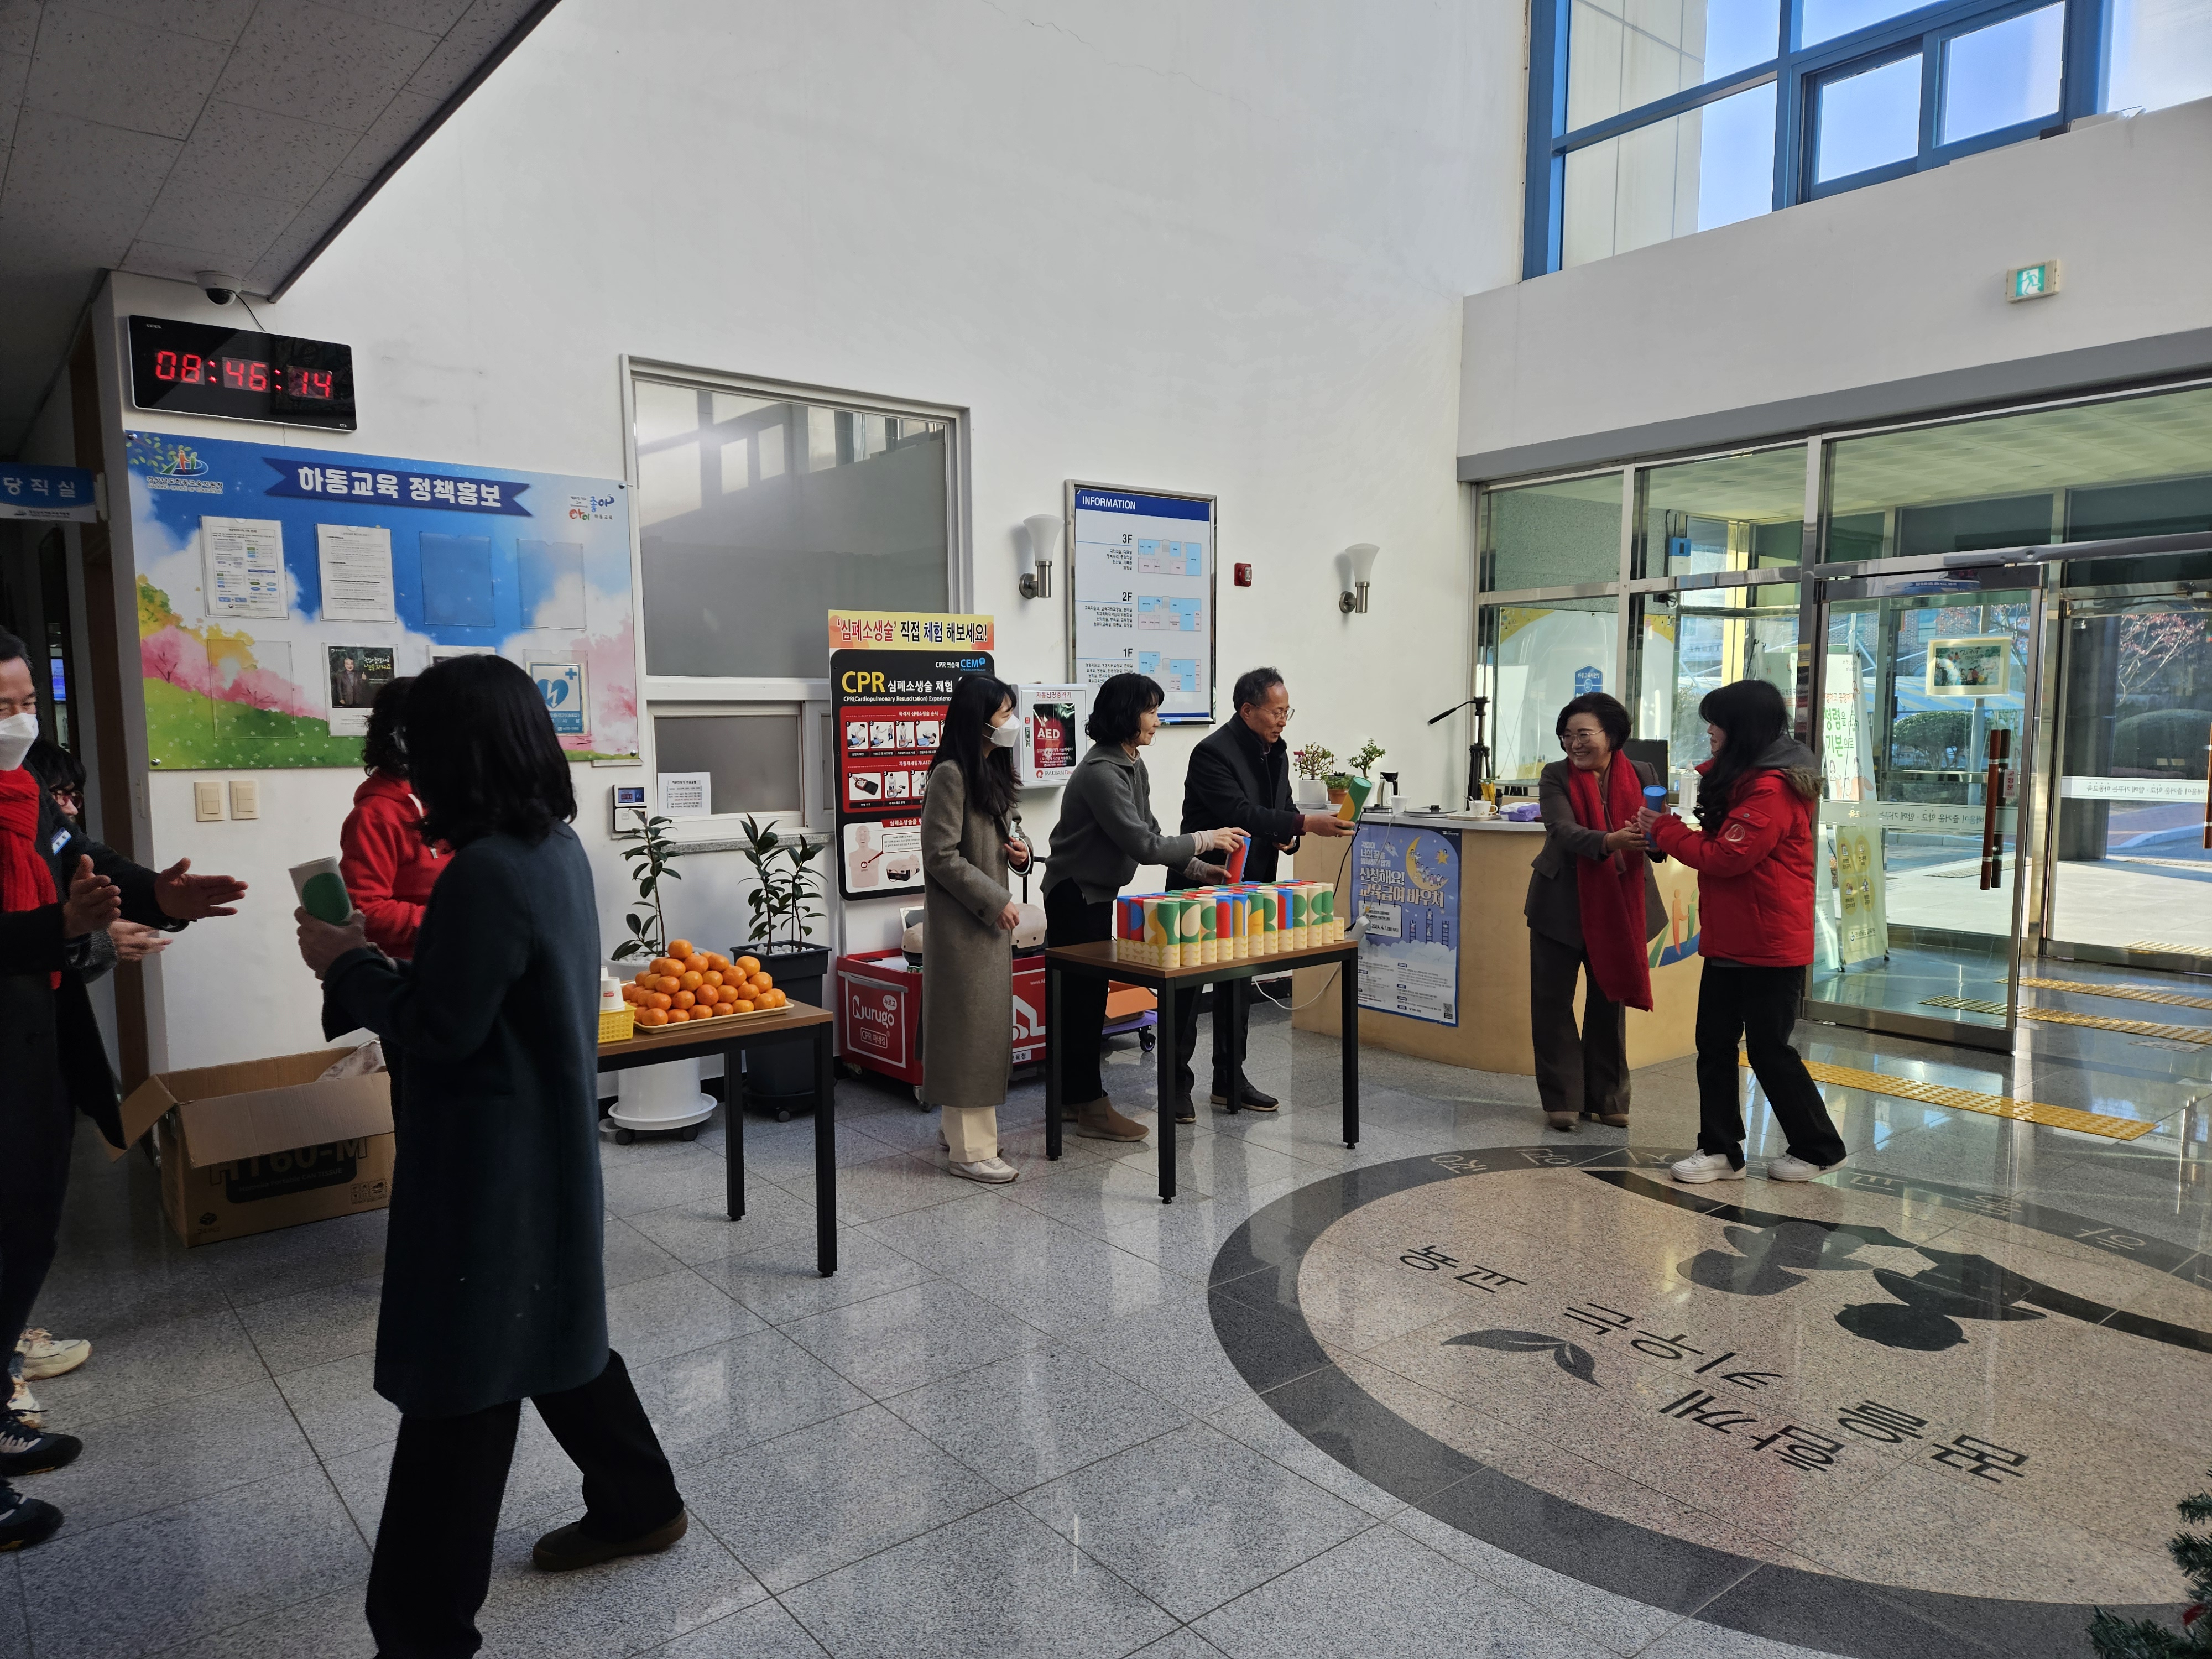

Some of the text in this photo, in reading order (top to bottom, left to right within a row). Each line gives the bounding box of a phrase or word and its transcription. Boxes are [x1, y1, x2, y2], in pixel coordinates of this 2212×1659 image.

[155, 351, 331, 398] 08:46:14
[3, 477, 76, 498] 당직실
[147, 476, 223, 489] 경상남도하동교육지원청
[298, 466, 502, 507] 하동교육 정책홍보
[1082, 495, 1136, 510] INFORMATION
[1122, 534, 1133, 544] 3F
[1122, 591, 1133, 602] 2F
[900, 620, 920, 643] 직접
[924, 621, 943, 643] 체험
[946, 622, 987, 644] 해보세요!
[1123, 648, 1133, 658] 1F
[960, 659, 979, 668] CEM
[842, 671, 953, 693] CPR 심폐소생술 체험
[1037, 728, 1060, 739] AED
[1825, 734, 1855, 757] 기본으로
[1361, 841, 1375, 849] 걱정이
[1360, 848, 1373, 858] 너의
[1380, 859, 1391, 868] 않게
[1360, 867, 1405, 886] 신청해요!
[1359, 882, 1445, 908] 교육급여 바우처
[884, 998, 896, 1007] 누르고
[852, 995, 895, 1029] Nurugo
[862, 1030, 886, 1046] CPR 마네킹
[317, 1167, 343, 1177] TISSUE
[1399, 1245, 2030, 1483] 꿈을 키우는 교육
[1659, 1389, 1846, 1472] 함께
